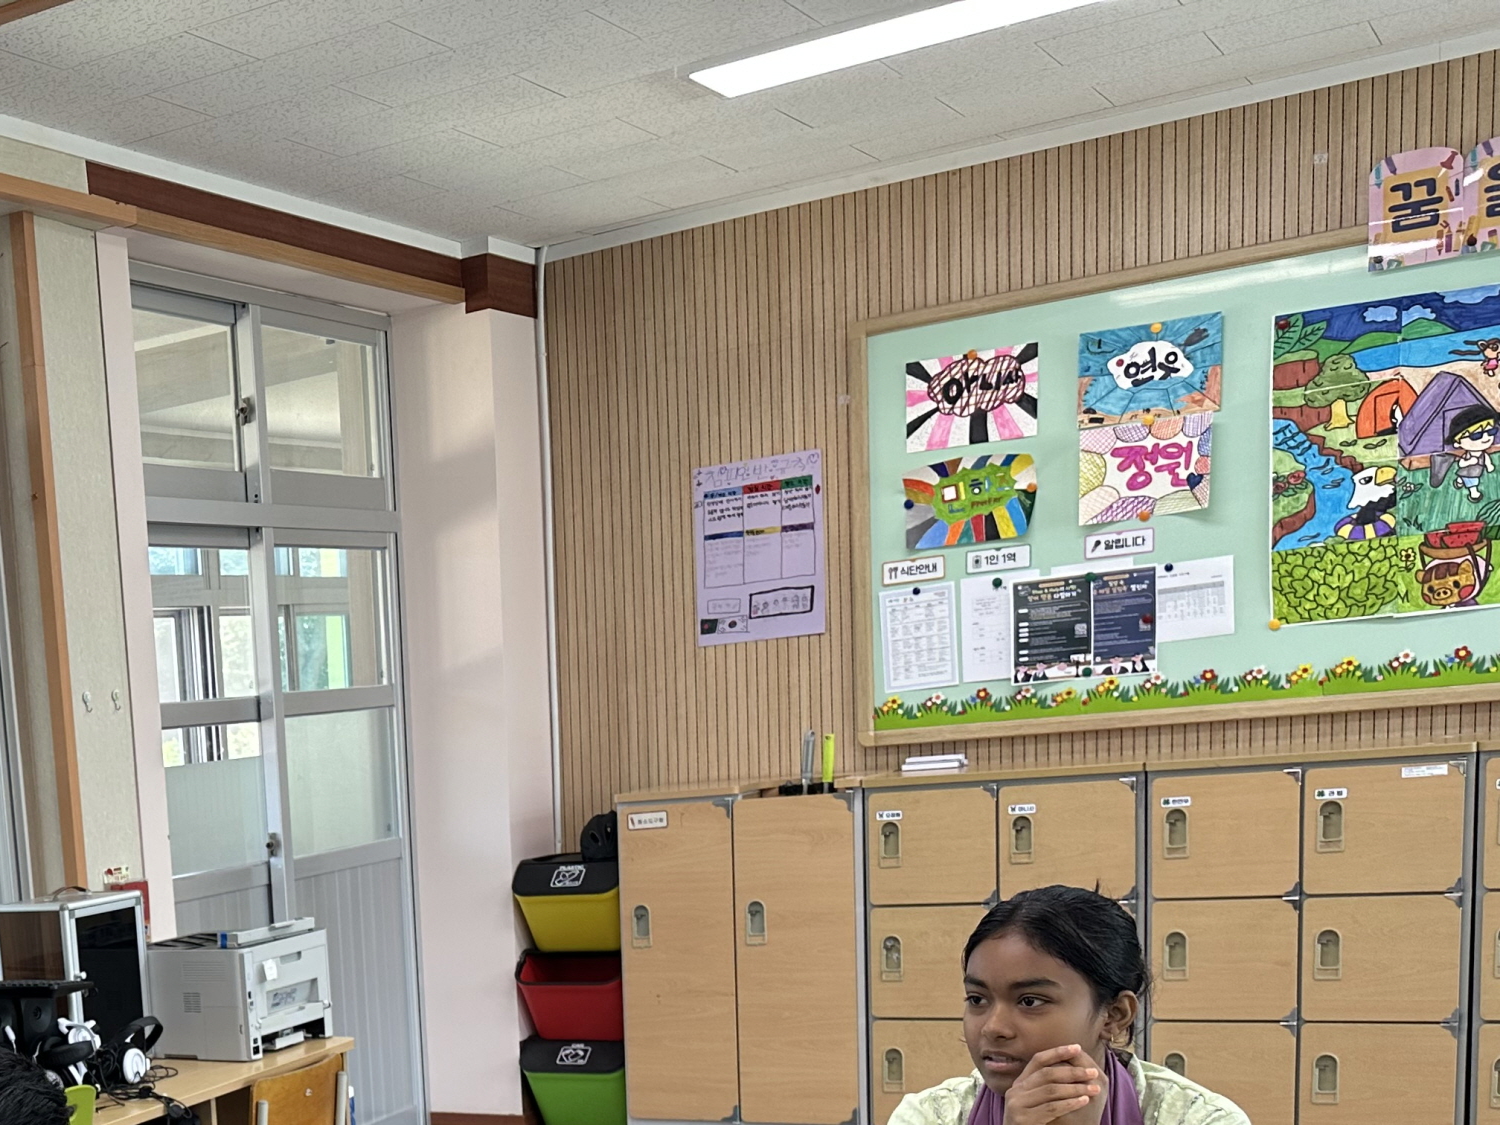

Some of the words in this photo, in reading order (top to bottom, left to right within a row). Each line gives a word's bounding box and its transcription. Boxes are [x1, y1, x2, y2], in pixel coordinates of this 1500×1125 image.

[1110, 440, 1193, 491] 정원
[1103, 535, 1146, 550] 알립니다
[900, 563, 937, 576] 식단안내
